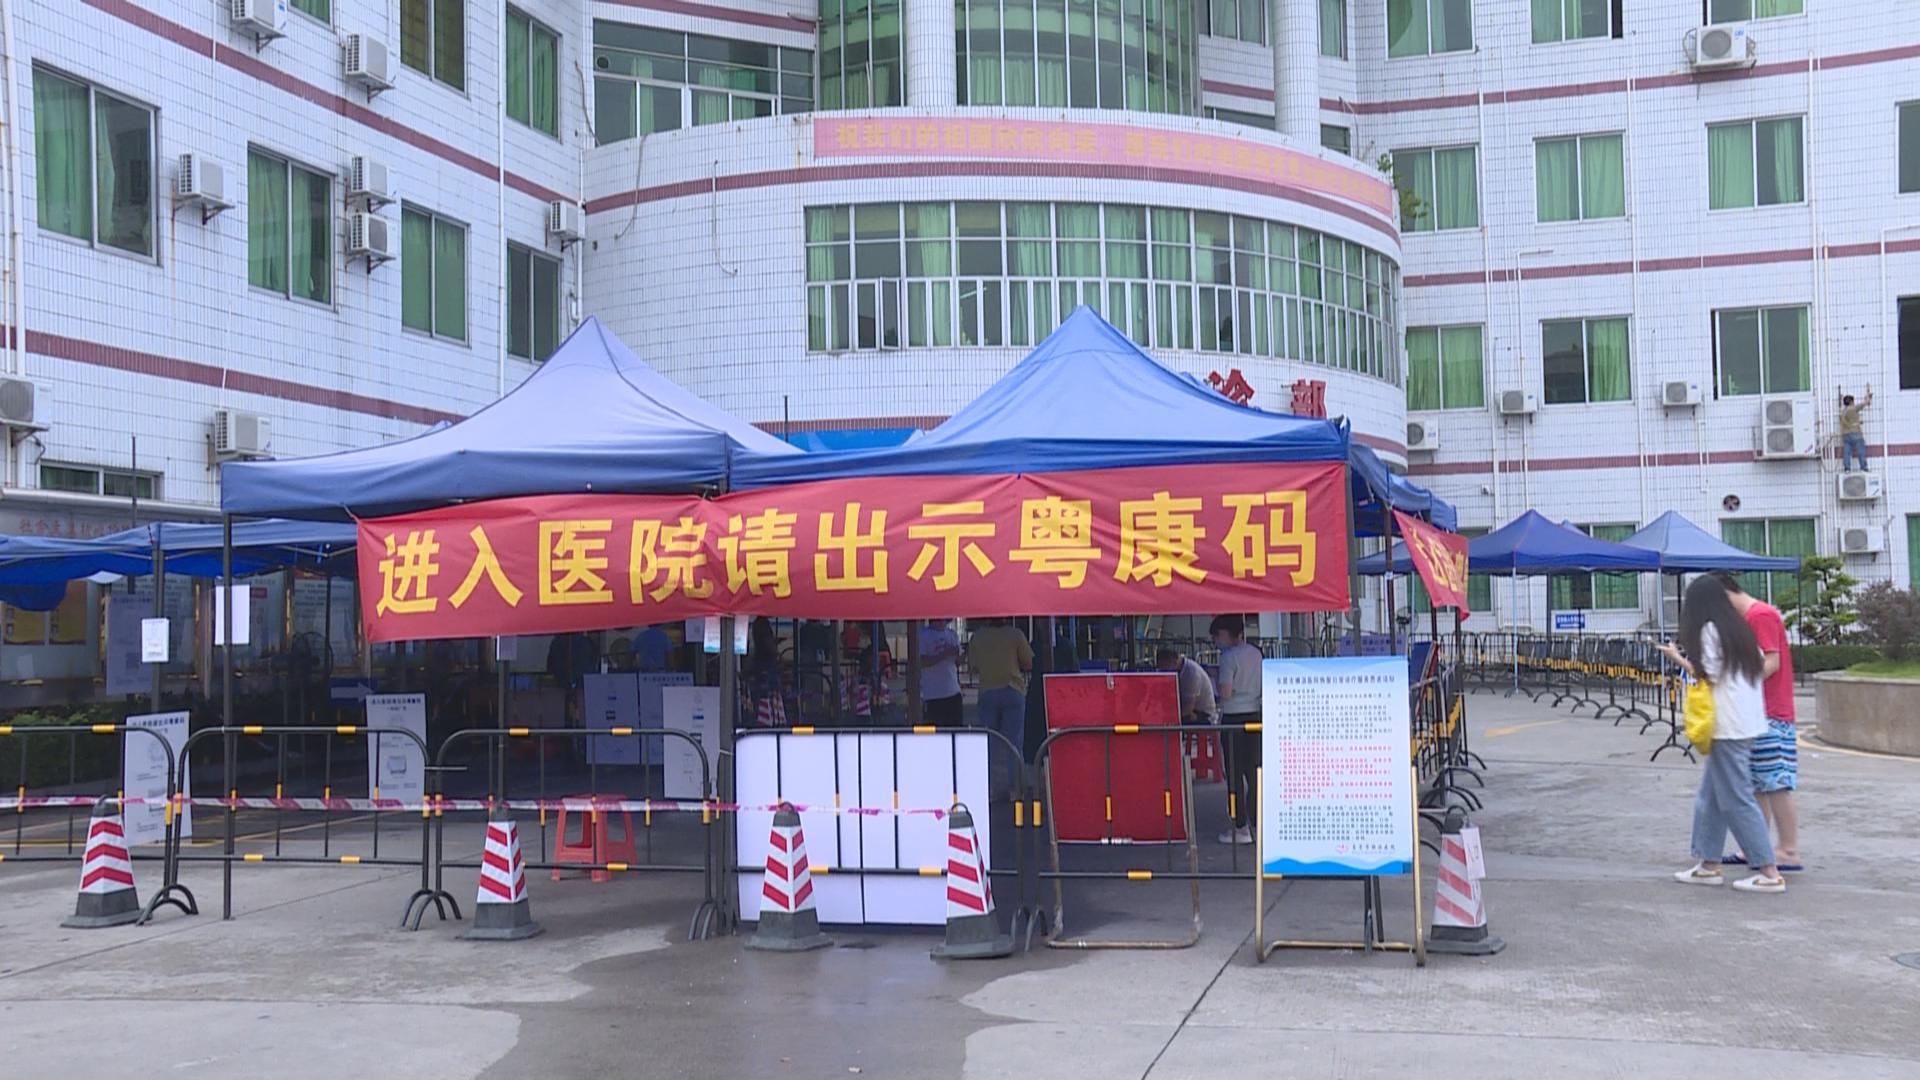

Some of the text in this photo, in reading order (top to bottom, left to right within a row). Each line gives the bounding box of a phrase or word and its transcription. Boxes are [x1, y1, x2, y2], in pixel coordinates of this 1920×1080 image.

[376, 490, 1317, 615] 进入医院请出示粤康码
